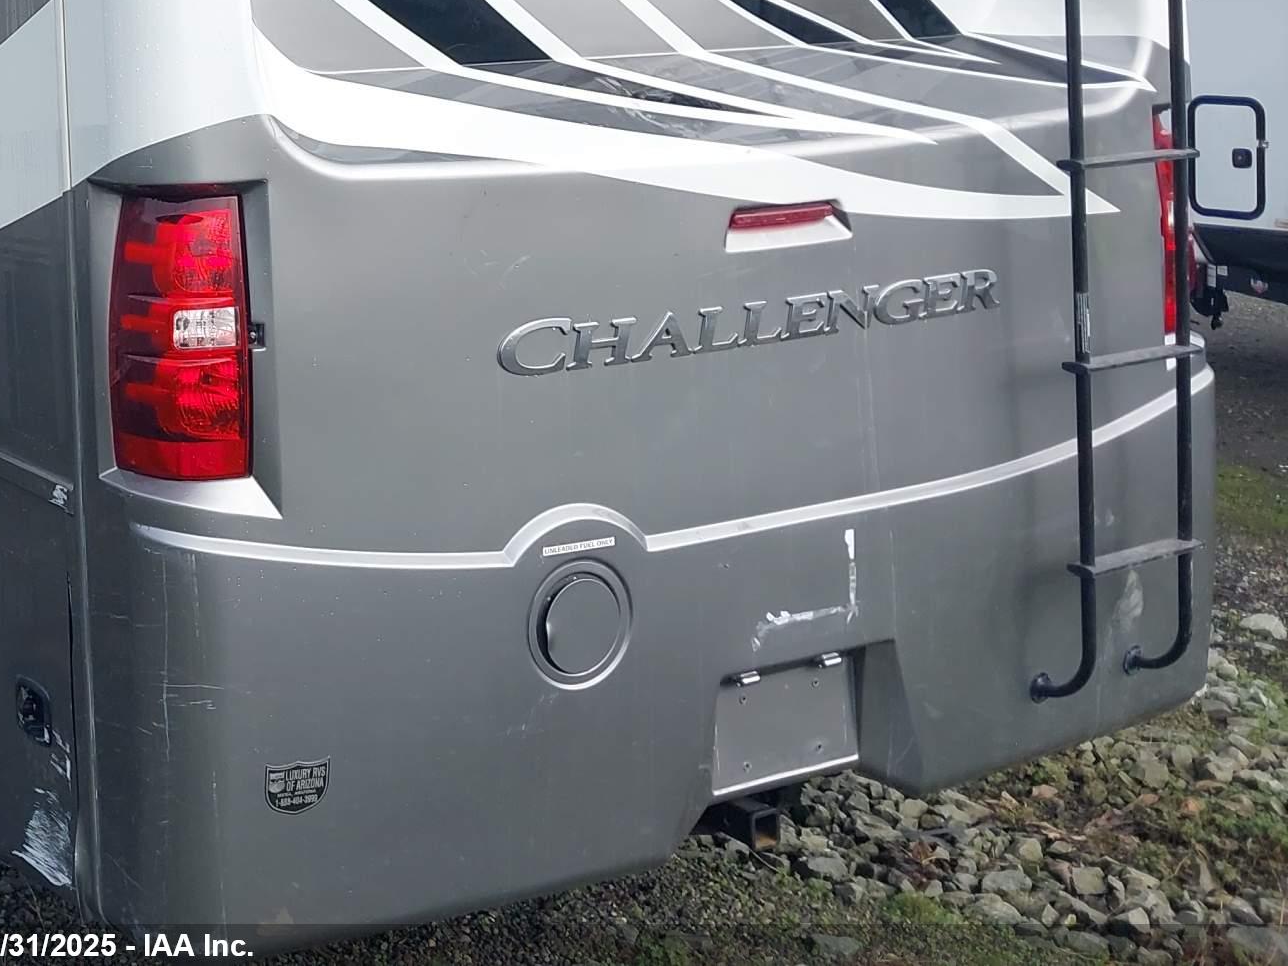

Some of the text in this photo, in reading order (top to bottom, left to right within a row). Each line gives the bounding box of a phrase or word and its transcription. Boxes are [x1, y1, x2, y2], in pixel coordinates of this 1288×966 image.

[497, 268, 1000, 377] CHALLENGER
[544, 545, 578, 554] UNLEADED
[596, 538, 613, 547] ONLY
[285, 768, 311, 781] LUXURY
[286, 777, 324, 792] OF ARIZONA
